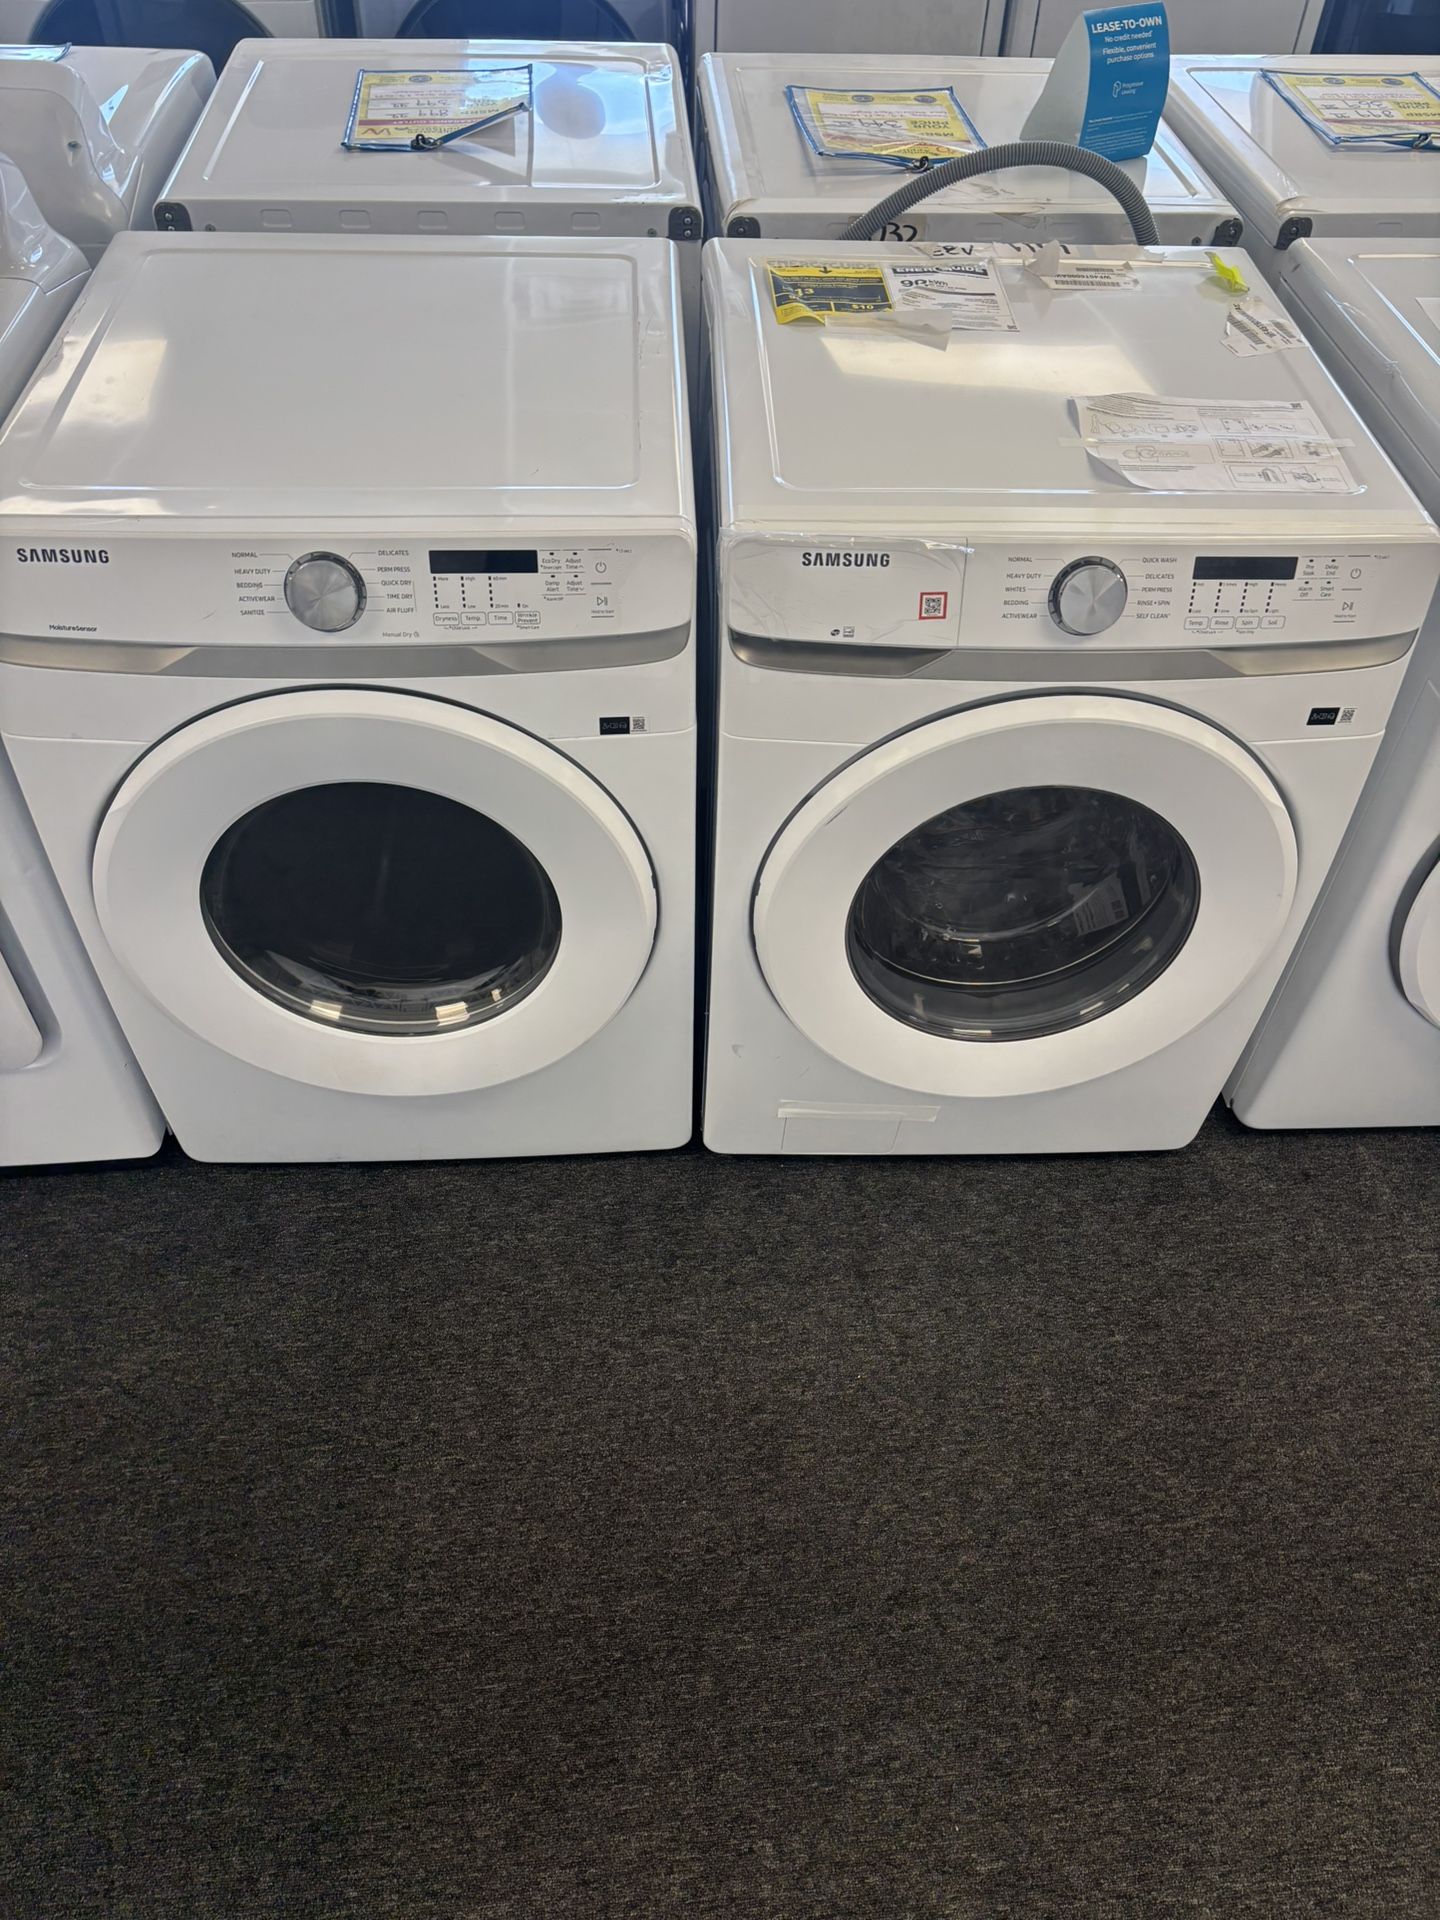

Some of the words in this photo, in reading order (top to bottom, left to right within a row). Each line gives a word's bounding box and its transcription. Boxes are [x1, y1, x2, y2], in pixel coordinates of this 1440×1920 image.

[1092, 16, 1162, 34] LEASE-TO-OWN
[1114, 33, 1131, 42] credit
[1127, 42, 1157, 52] convenient
[1107, 55, 1133, 65] purchase
[1134, 52, 1154, 61] options
[17, 548, 110, 564] SAMSUNG
[802, 552, 890, 567] SAMSUNG
[436, 615, 458, 623] Dryness
[49, 624, 98, 632] MoistureSensor
[403, 631, 413, 639] Dry
